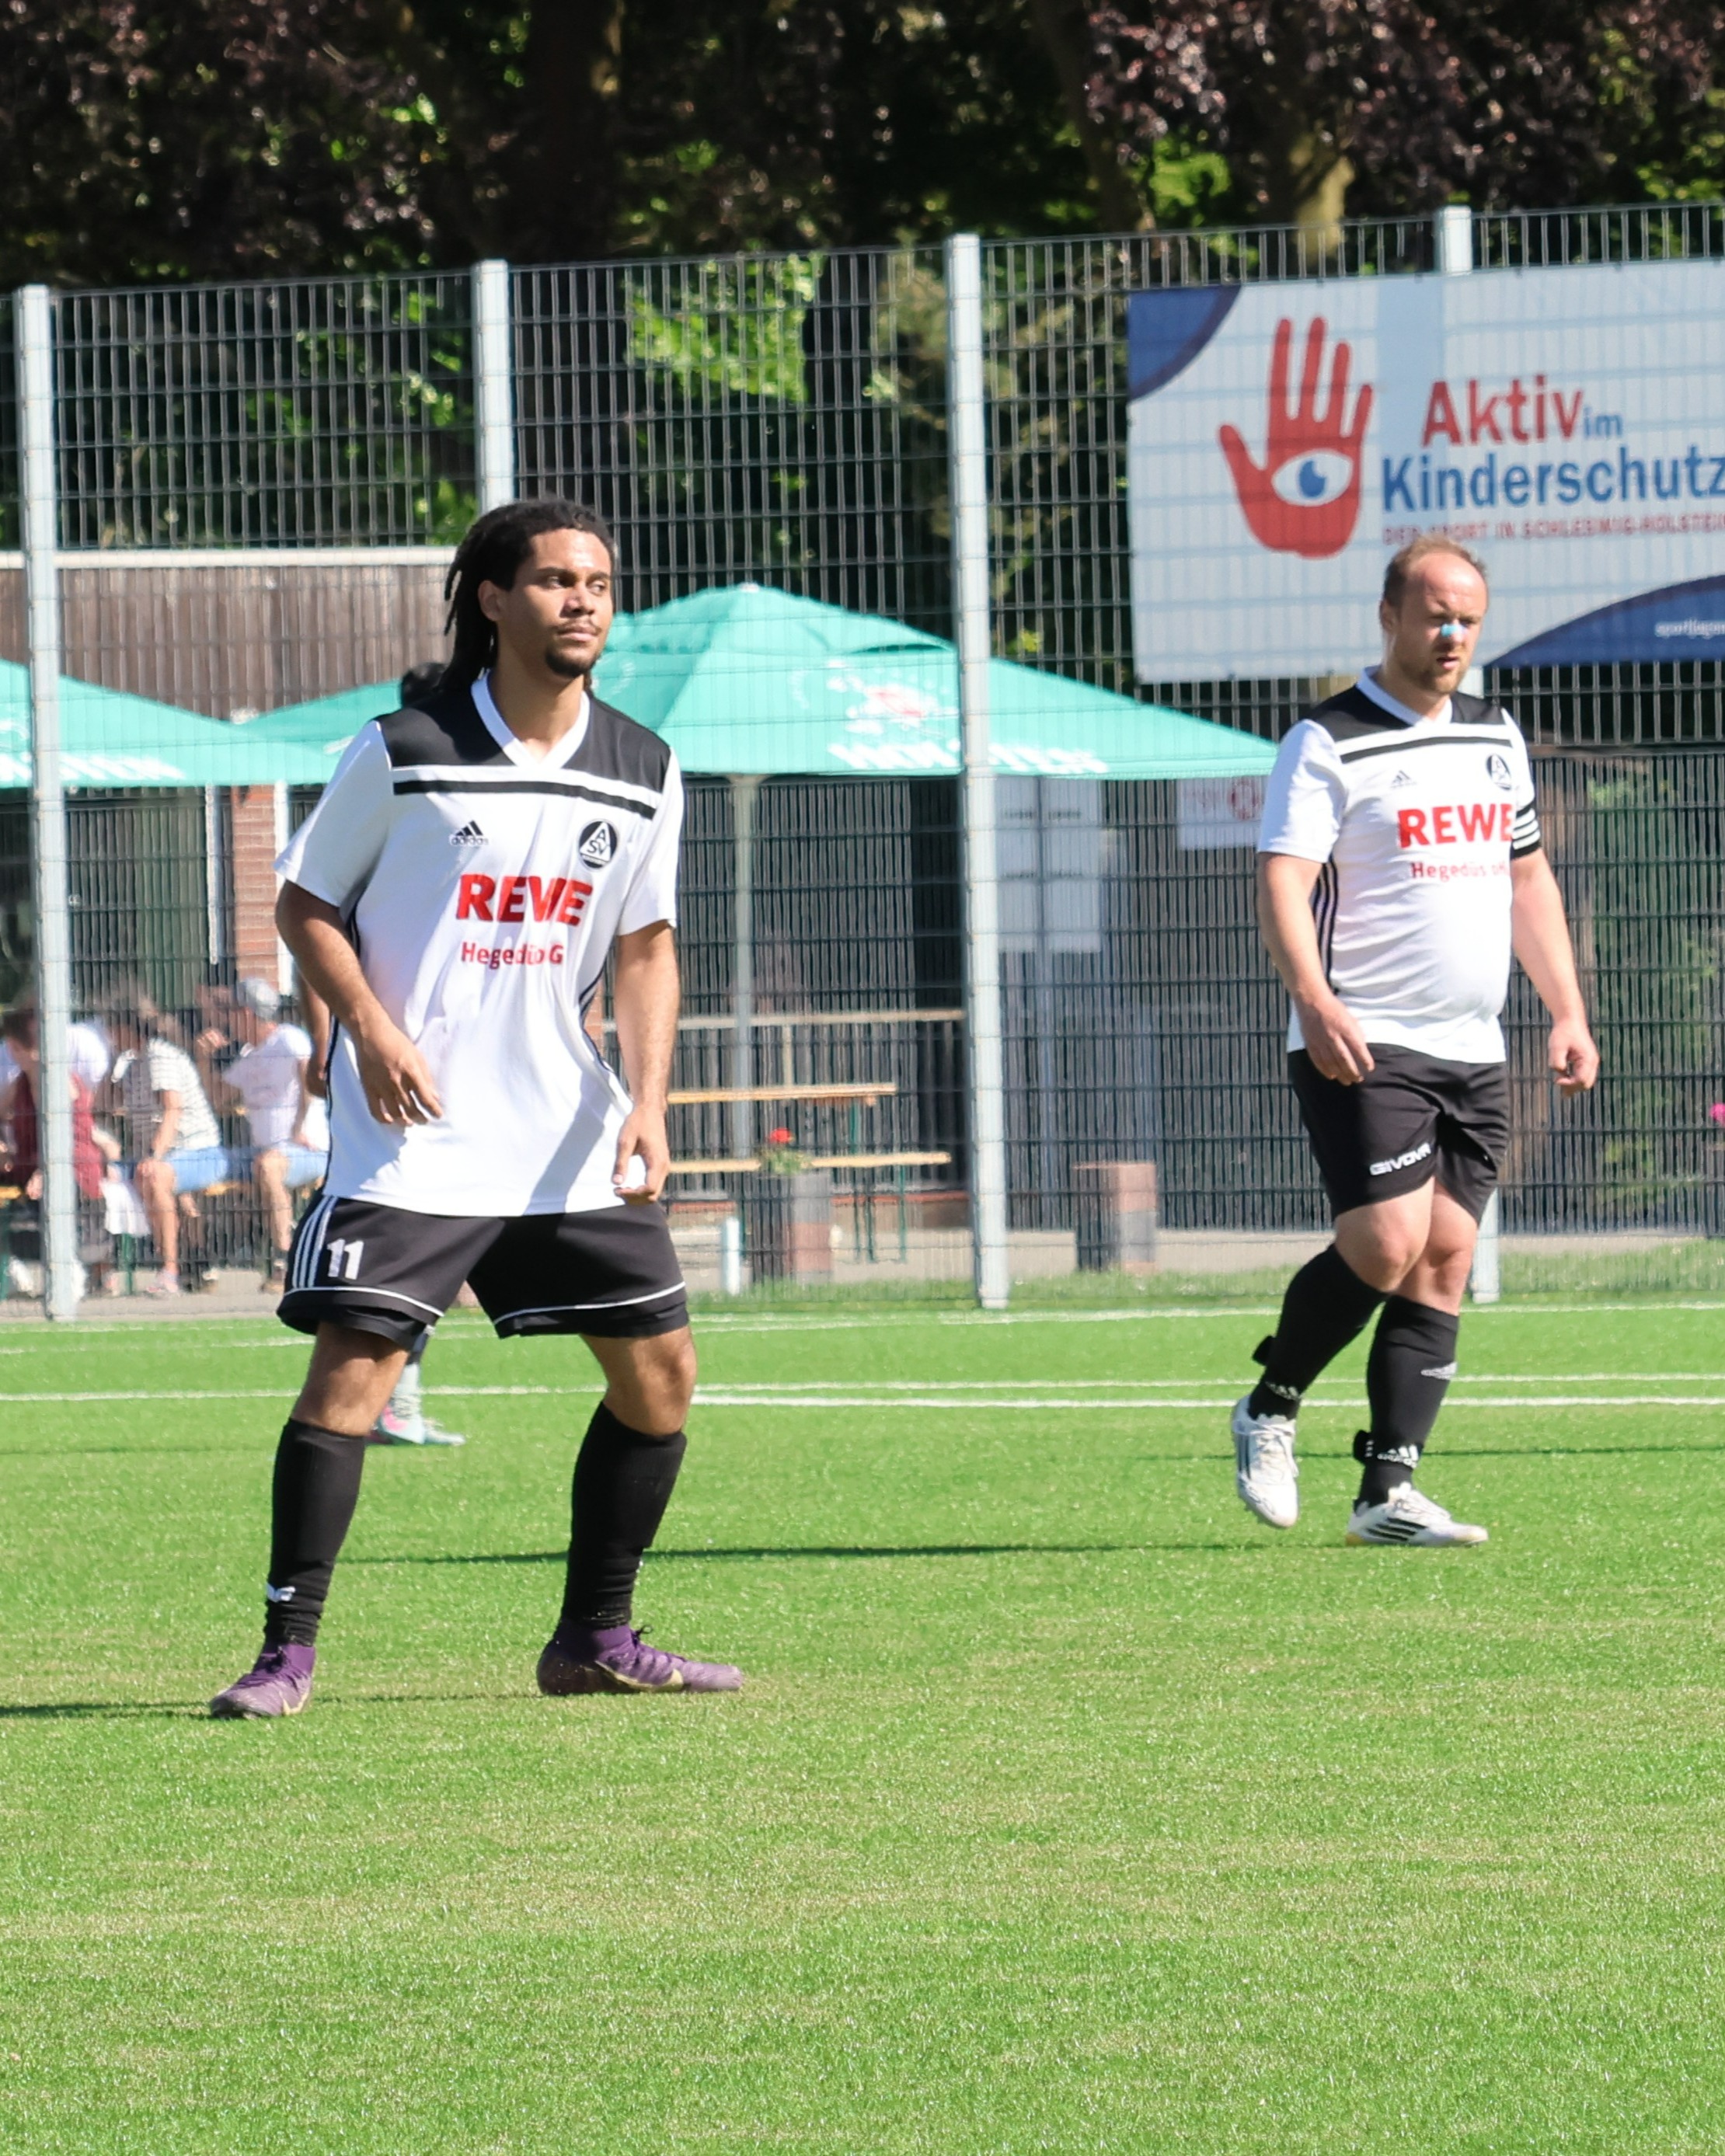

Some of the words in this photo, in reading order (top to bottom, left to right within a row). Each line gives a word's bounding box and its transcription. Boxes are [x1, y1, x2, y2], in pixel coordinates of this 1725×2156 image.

[1421, 374, 1584, 448] Aktiv
[1584, 406, 1624, 441] im
[1382, 444, 1725, 511] Kinderschutz
[1397, 803, 1513, 848] REWE
[326, 1238, 364, 1280] 11
